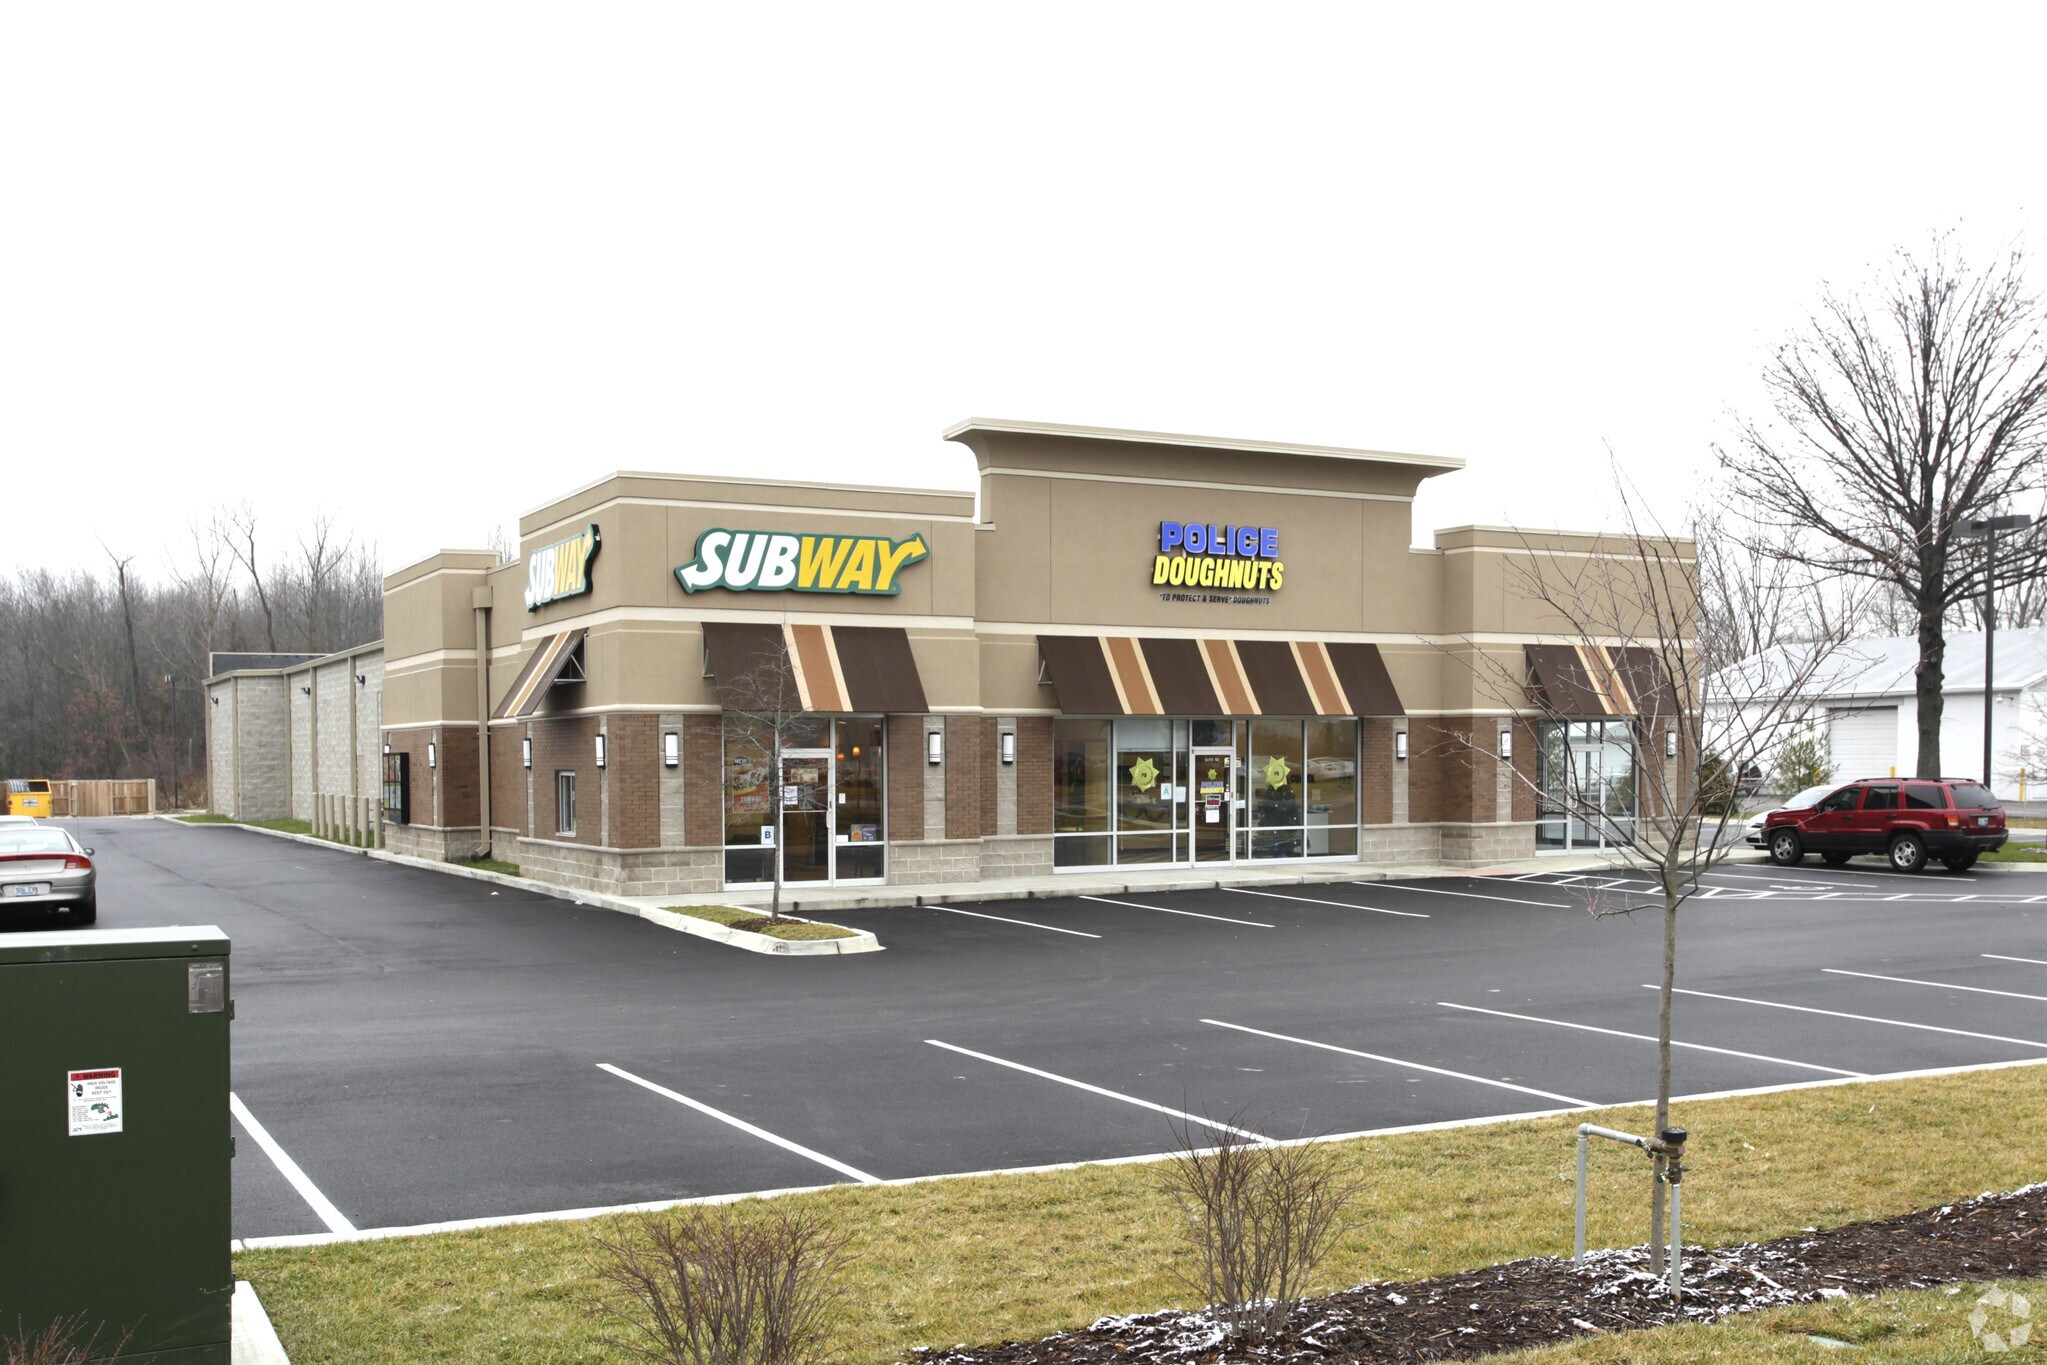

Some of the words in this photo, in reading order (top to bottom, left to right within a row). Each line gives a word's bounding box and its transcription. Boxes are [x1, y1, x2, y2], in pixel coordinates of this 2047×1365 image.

[1160, 521, 1279, 558] POLICE
[523, 529, 594, 609] SUBWAY
[680, 531, 927, 591] SUBWAY
[1152, 555, 1285, 591] DOUGHNUTS
[1171, 593, 1201, 603] PROTECT
[1232, 596, 1271, 605] DOUGHNUTS
[1163, 787, 1170, 796] A
[764, 830, 772, 839] B
[83, 1071, 116, 1080] WARNING
